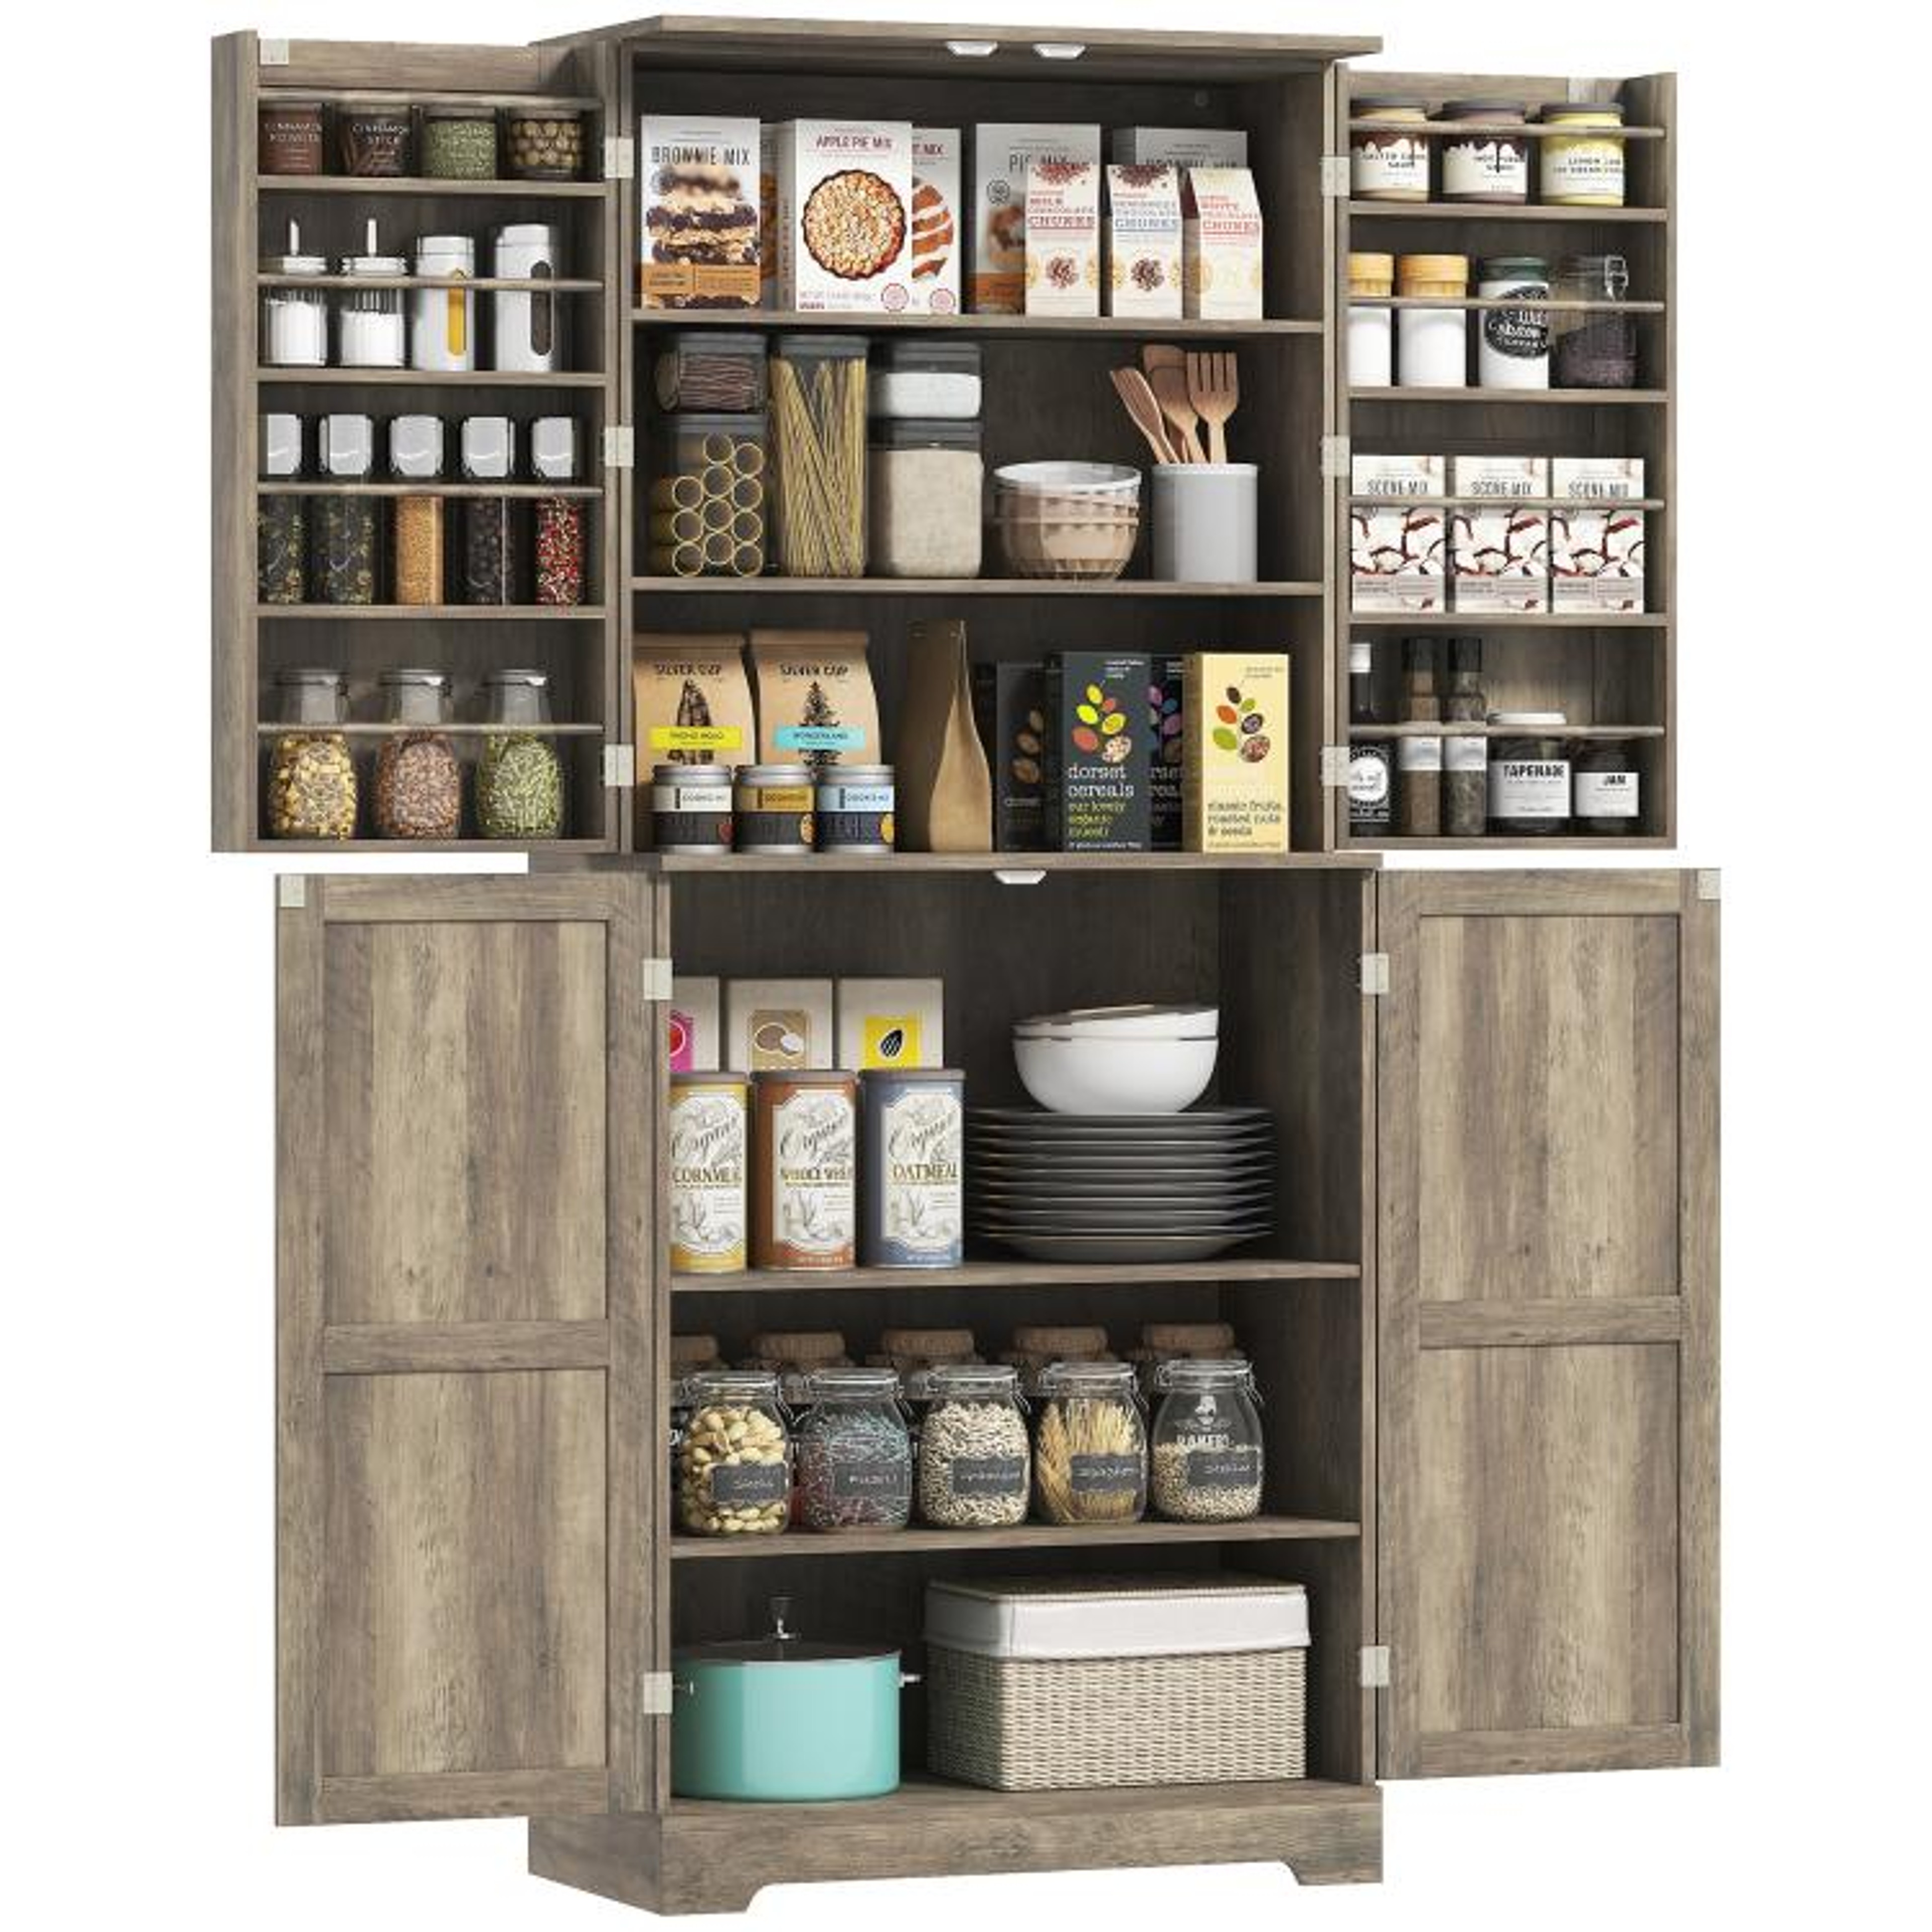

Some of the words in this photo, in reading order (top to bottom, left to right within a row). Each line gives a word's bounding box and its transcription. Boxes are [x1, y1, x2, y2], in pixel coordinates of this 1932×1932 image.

[816, 136, 850, 147] APPLE
[852, 136, 869, 147] PIE
[651, 146, 716, 166] BROWNIE
[723, 147, 751, 166] MIX
[1068, 763, 1126, 779] dorset
[1603, 775, 1626, 786] JAM
[1068, 782, 1135, 797] cereals
[893, 1163, 957, 1180] OATMEAL
